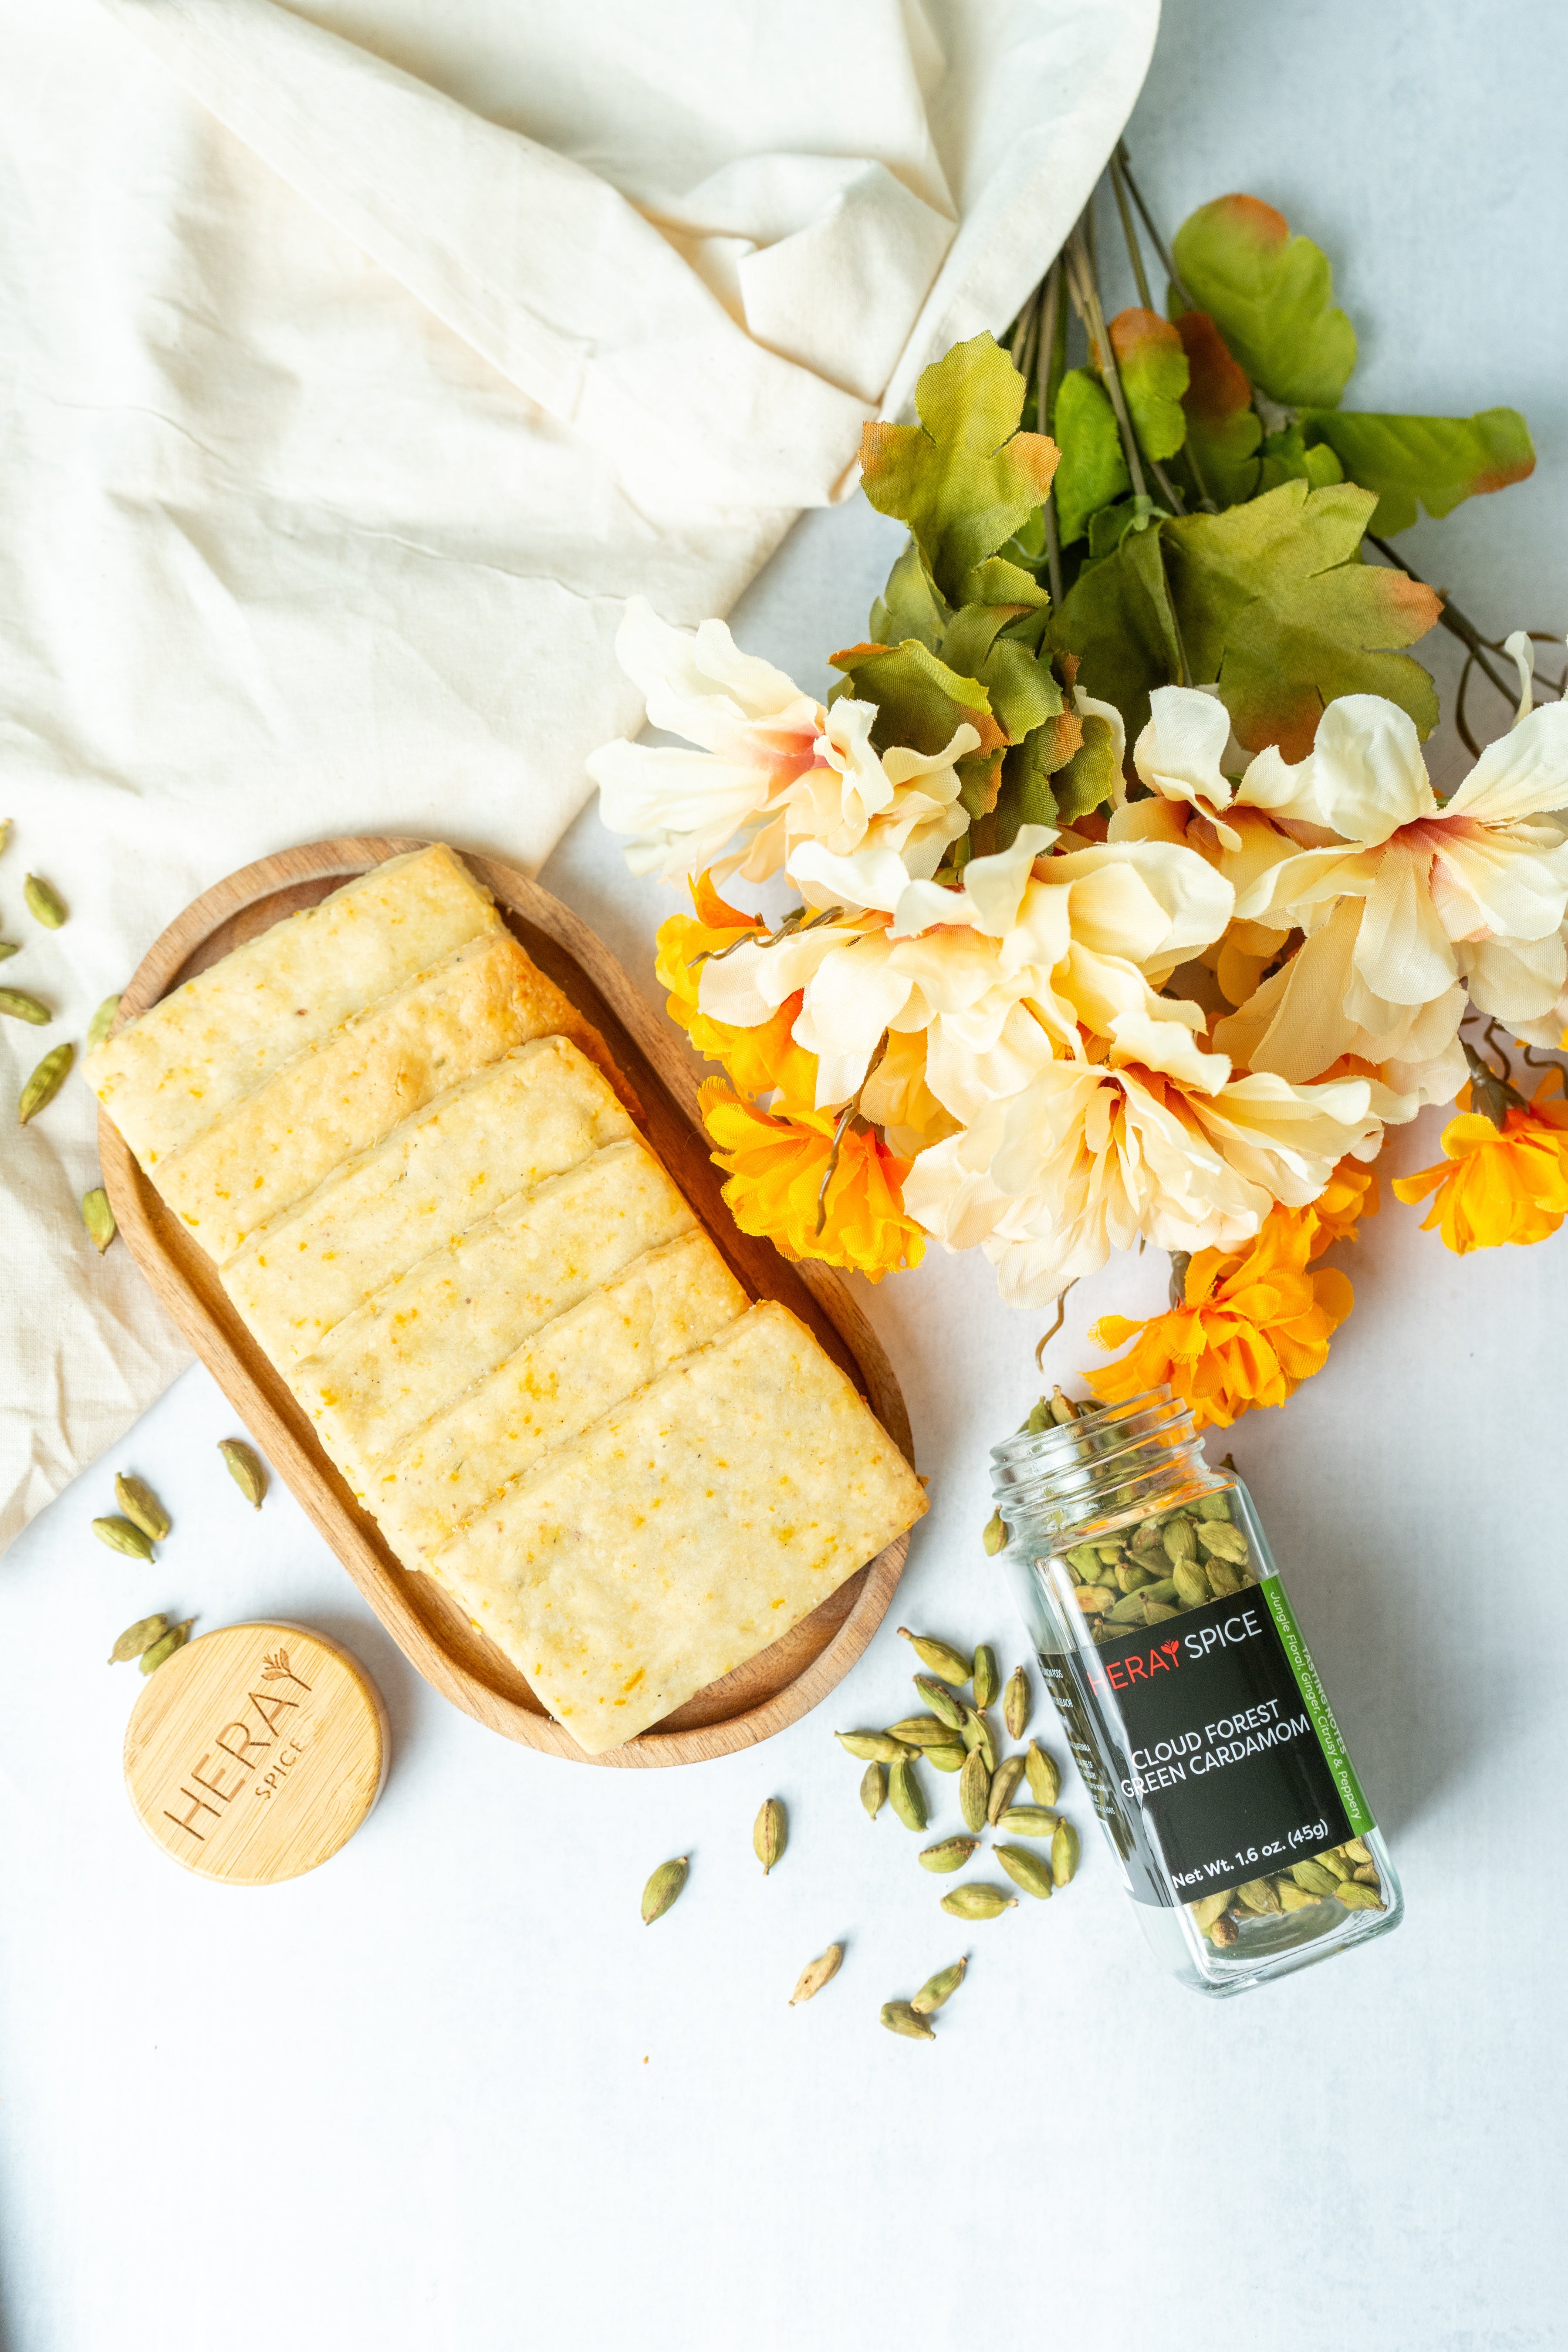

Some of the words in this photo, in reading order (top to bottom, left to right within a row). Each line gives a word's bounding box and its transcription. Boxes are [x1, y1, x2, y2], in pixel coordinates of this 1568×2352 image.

[1184, 1610, 1262, 1659] SPICE
[1131, 1732, 1201, 1769] CLOUD
[1205, 1699, 1279, 1744] FOREST
[1270, 1592, 1290, 1632] Jungle
[1286, 1634, 1306, 1670] Floral,
[1301, 1673, 1321, 1714] Ginger,
[1318, 1716, 1338, 1756] Citrusy
[1333, 1758, 1343, 1769] &
[1338, 1771, 1362, 1819] Peppery
[1302, 1645, 1328, 1705] TASTING
[1325, 1707, 1347, 1755] NOTES
[255, 1738, 307, 1800] SPICE
[1121, 1762, 1186, 1798] GREEN
[1190, 1714, 1311, 1775] CARDAMOM
[1171, 1869, 1203, 1889] Net
[1203, 1860, 1234, 1877] Wt.
[1235, 1848, 1258, 1865] 1.6
[1262, 1841, 1286, 1856] oz.
[1288, 1818, 1328, 1849] (45g)
